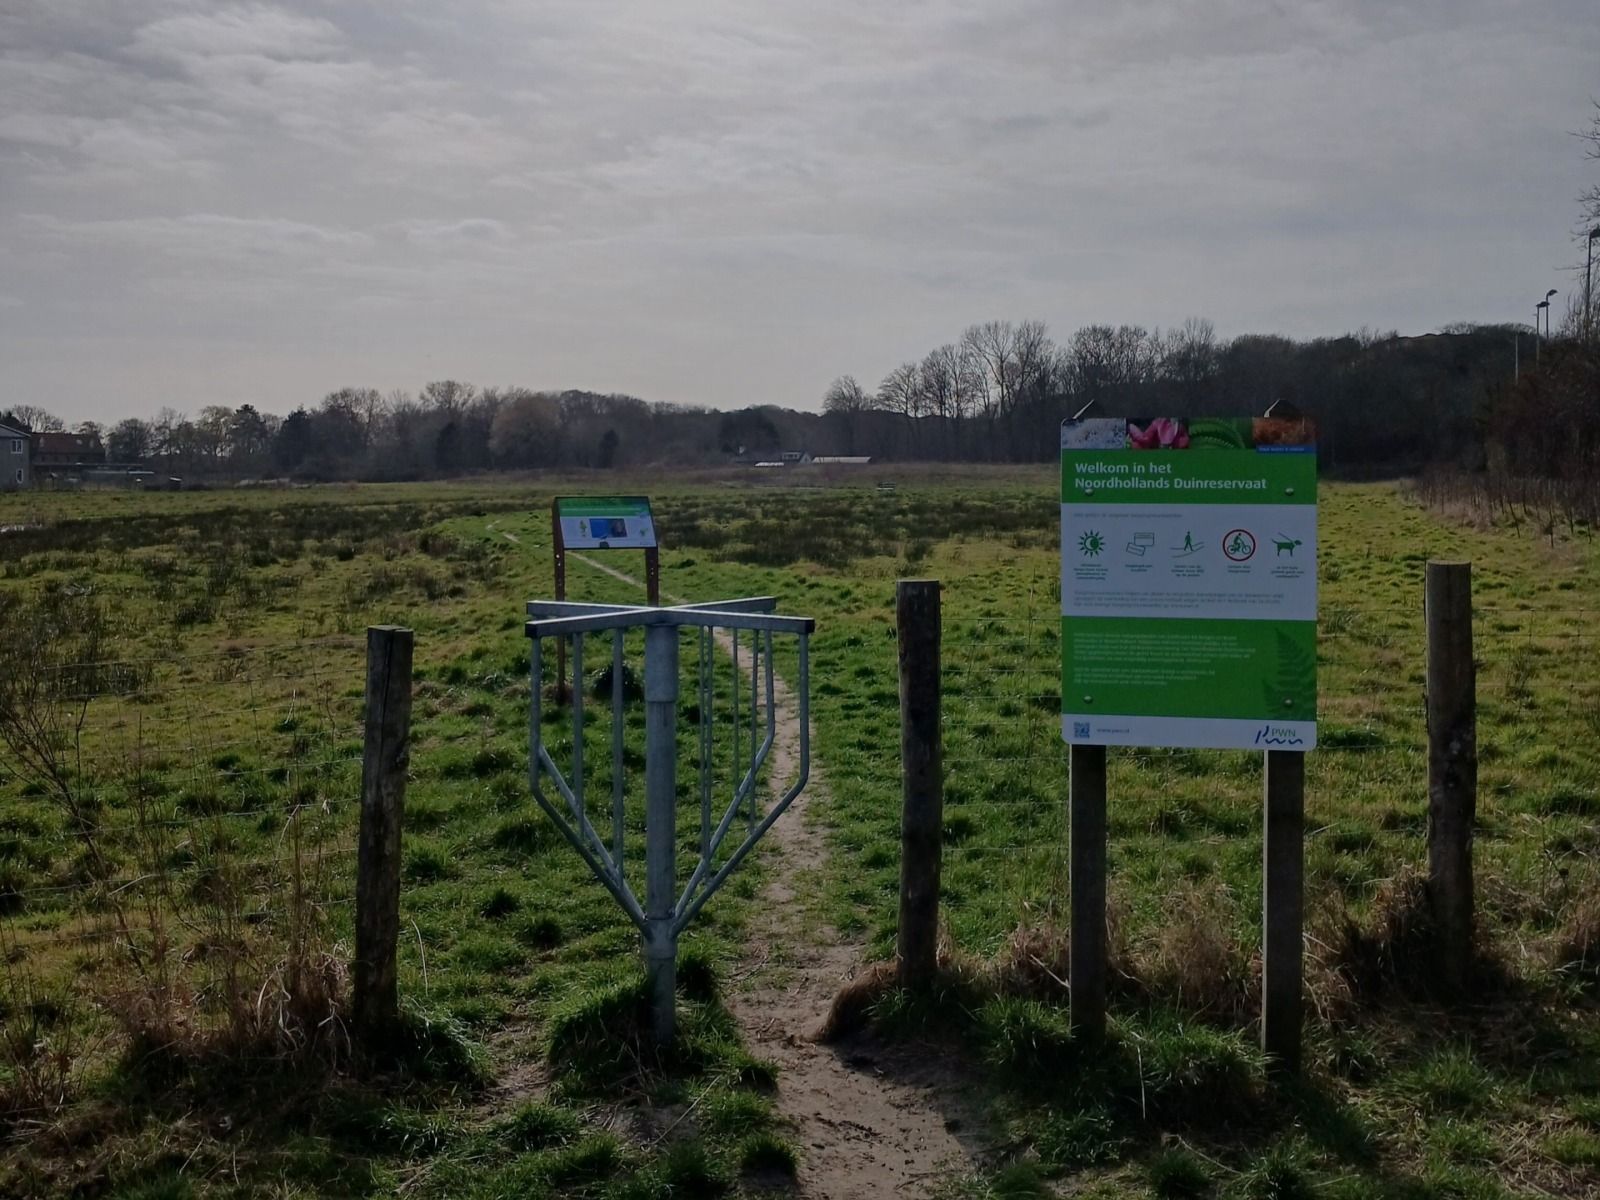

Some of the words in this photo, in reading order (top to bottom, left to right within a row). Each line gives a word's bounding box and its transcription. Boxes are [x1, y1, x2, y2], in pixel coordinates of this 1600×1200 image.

[1075, 462, 1129, 474] Welkom
[1133, 462, 1145, 474] in
[1149, 462, 1172, 474] het
[1075, 477, 1170, 489] Noordhollands
[1174, 478, 1267, 490] Duinreservaat
[1271, 728, 1296, 737] PWN
